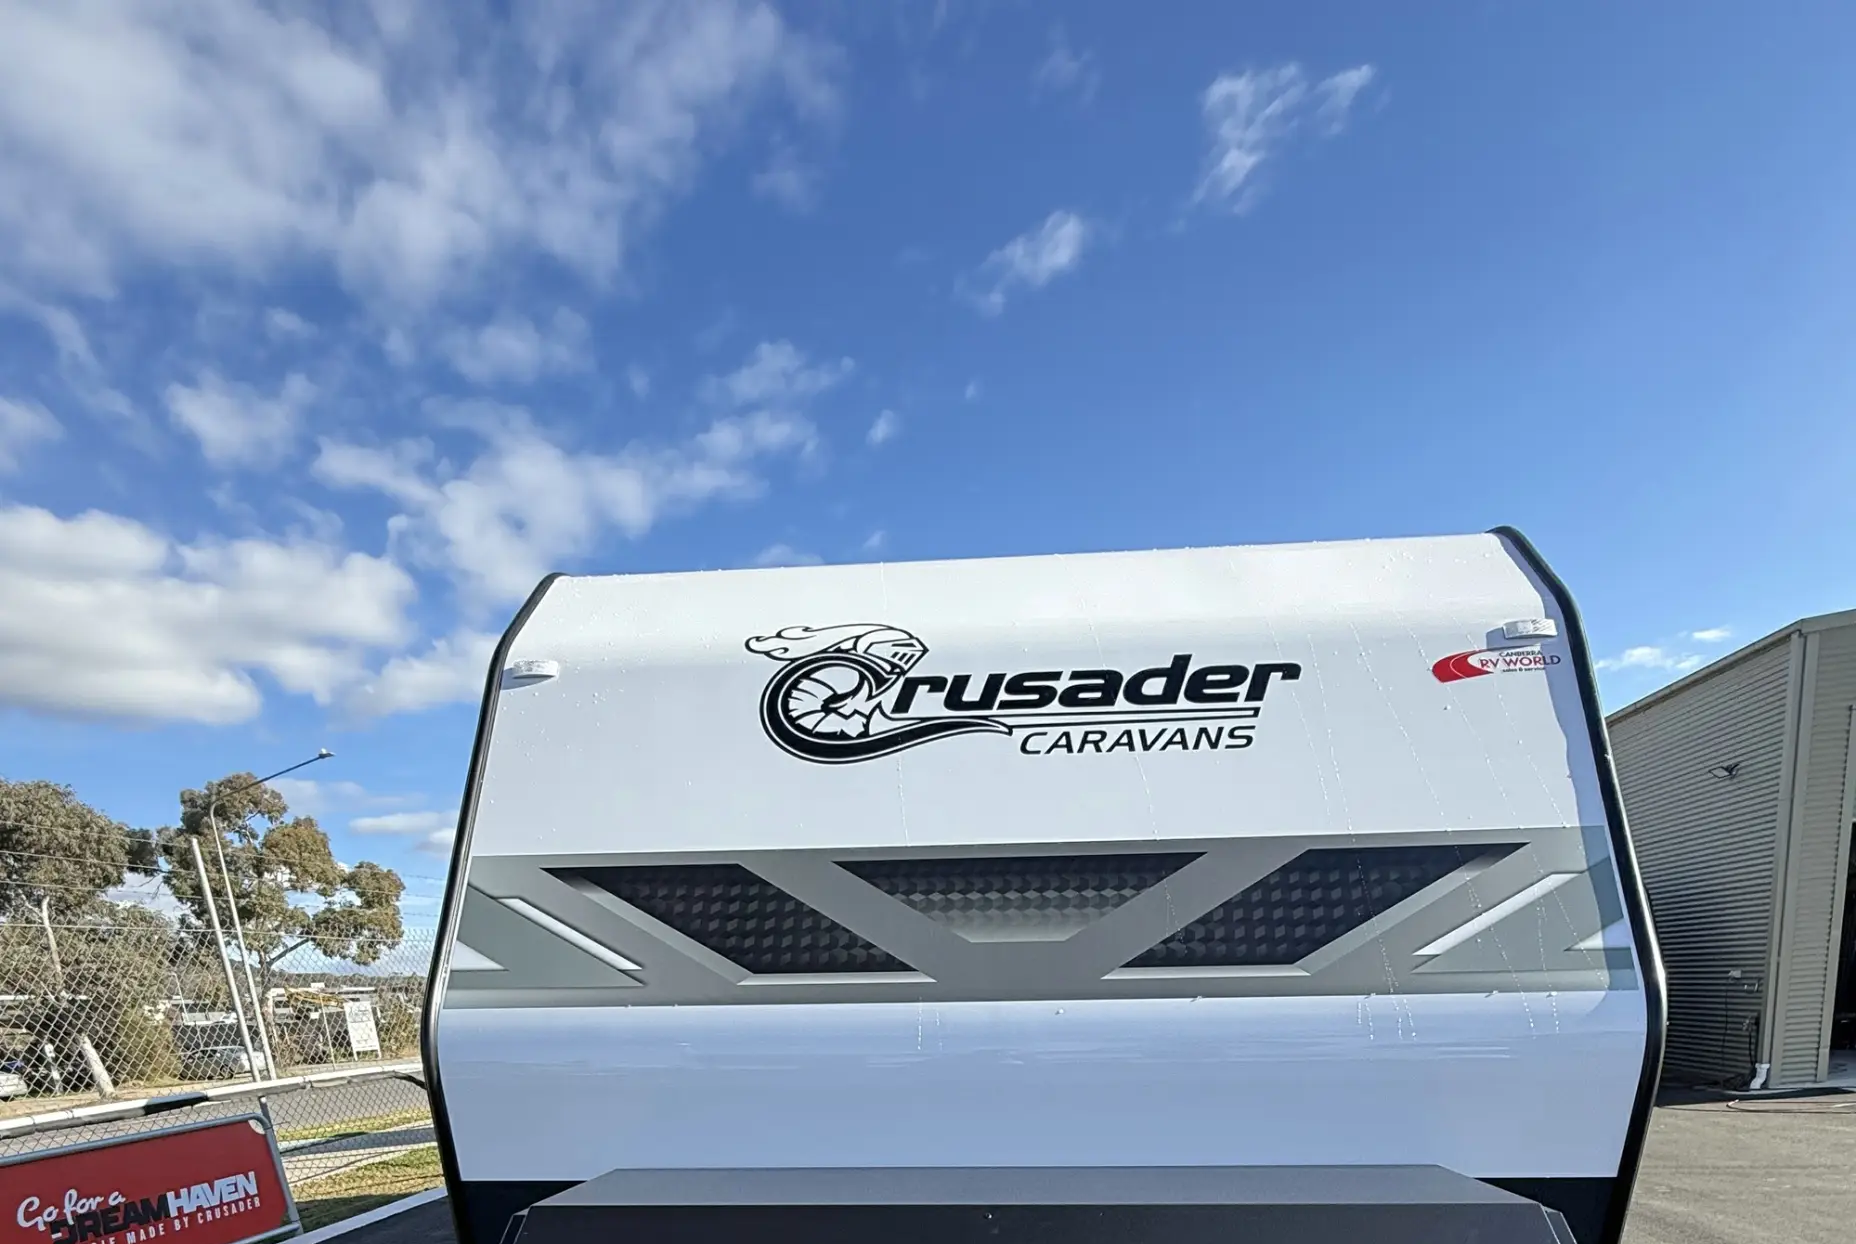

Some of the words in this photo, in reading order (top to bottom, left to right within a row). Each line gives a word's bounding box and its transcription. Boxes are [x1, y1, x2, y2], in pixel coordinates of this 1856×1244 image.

[1479, 658, 1499, 668] RV
[1503, 654, 1562, 667] WORLD
[759, 650, 1302, 765] Crusader
[1019, 725, 1256, 755] CARAVANS
[17, 1196, 59, 1231] Go
[63, 1188, 104, 1225] for
[108, 1191, 126, 1205] a
[126, 1223, 167, 1244] MADE
[174, 1215, 190, 1231] BY
[197, 1197, 261, 1225] CRUSADER
